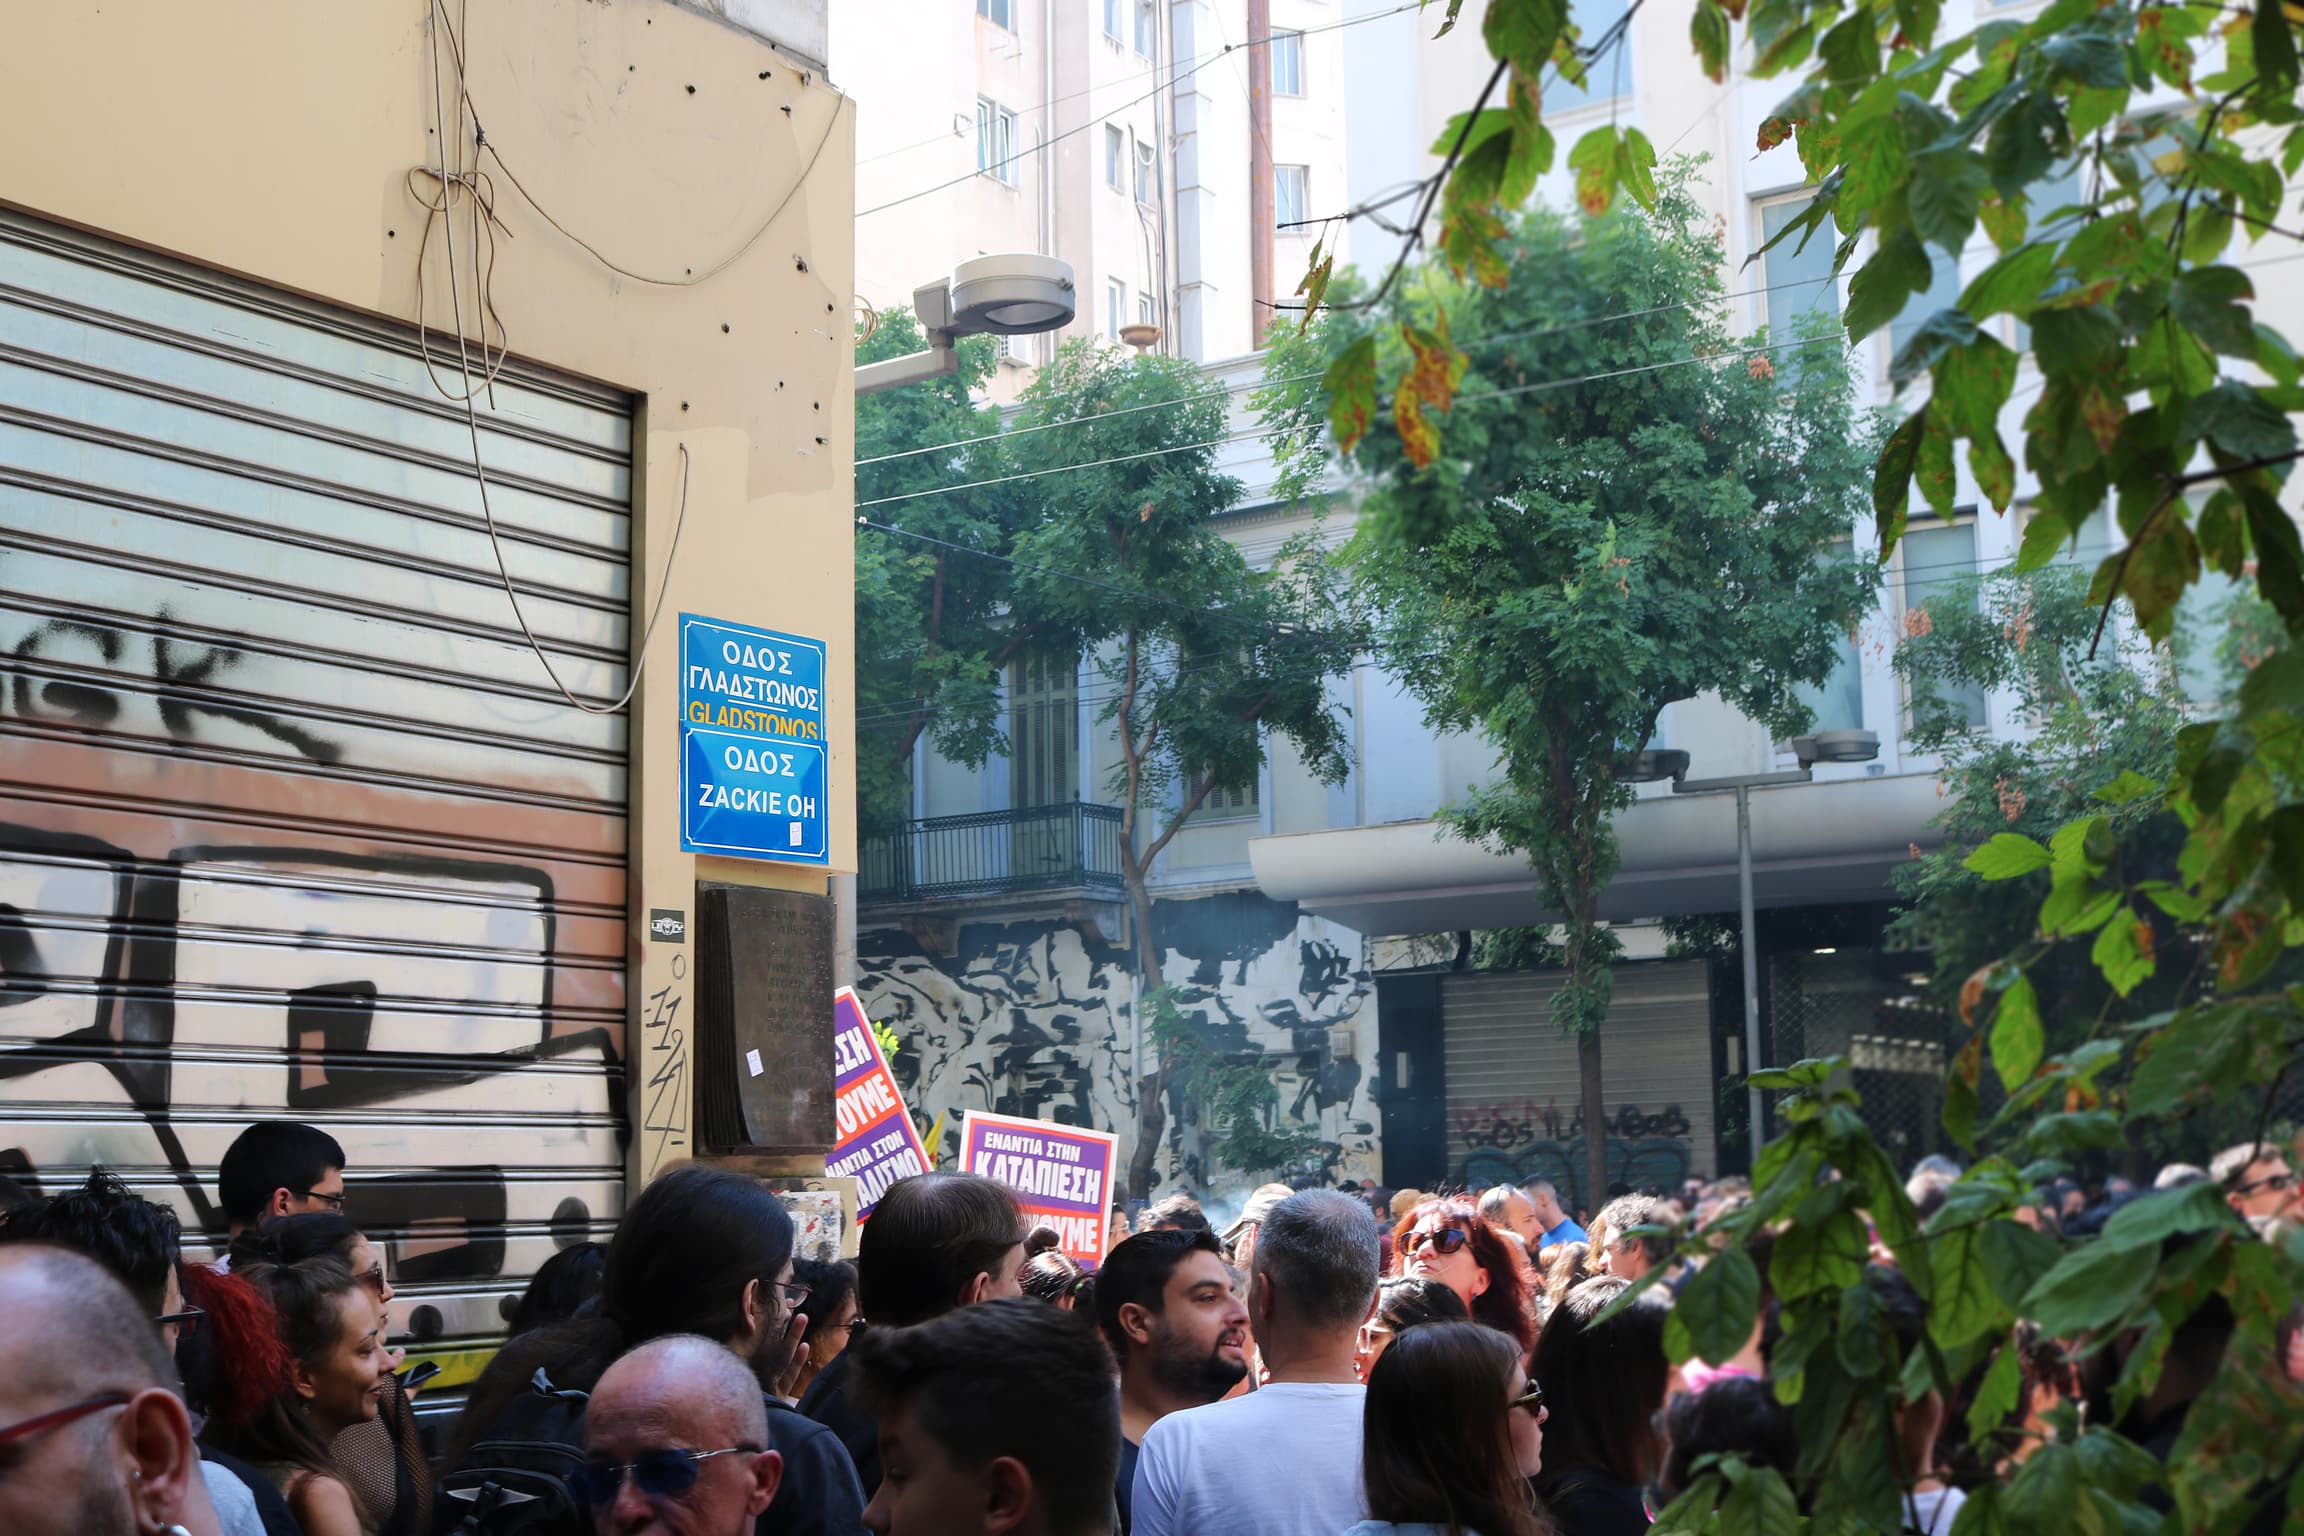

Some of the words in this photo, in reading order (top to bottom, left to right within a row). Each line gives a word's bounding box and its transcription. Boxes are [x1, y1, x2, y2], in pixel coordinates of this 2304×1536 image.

[723, 640, 793, 676] ΟΔΟΣ
[689, 665, 819, 712] ΓΛΑΔΣΤΩΝΟΣ
[689, 700, 819, 740] GLADSTONOS
[724, 745, 795, 777] ΟΔΟΣ
[698, 783, 782, 815] ZACKIE
[787, 794, 816, 819] OH
[871, 1129, 906, 1160] ΣΤΟΝ
[984, 1131, 1043, 1156] ΕΝΑΝΤΙΑ
[1046, 1141, 1081, 1163] ΣΤΗΝ
[974, 1151, 1102, 1205] ΚΑΤΑΠΙΕΣΗ
